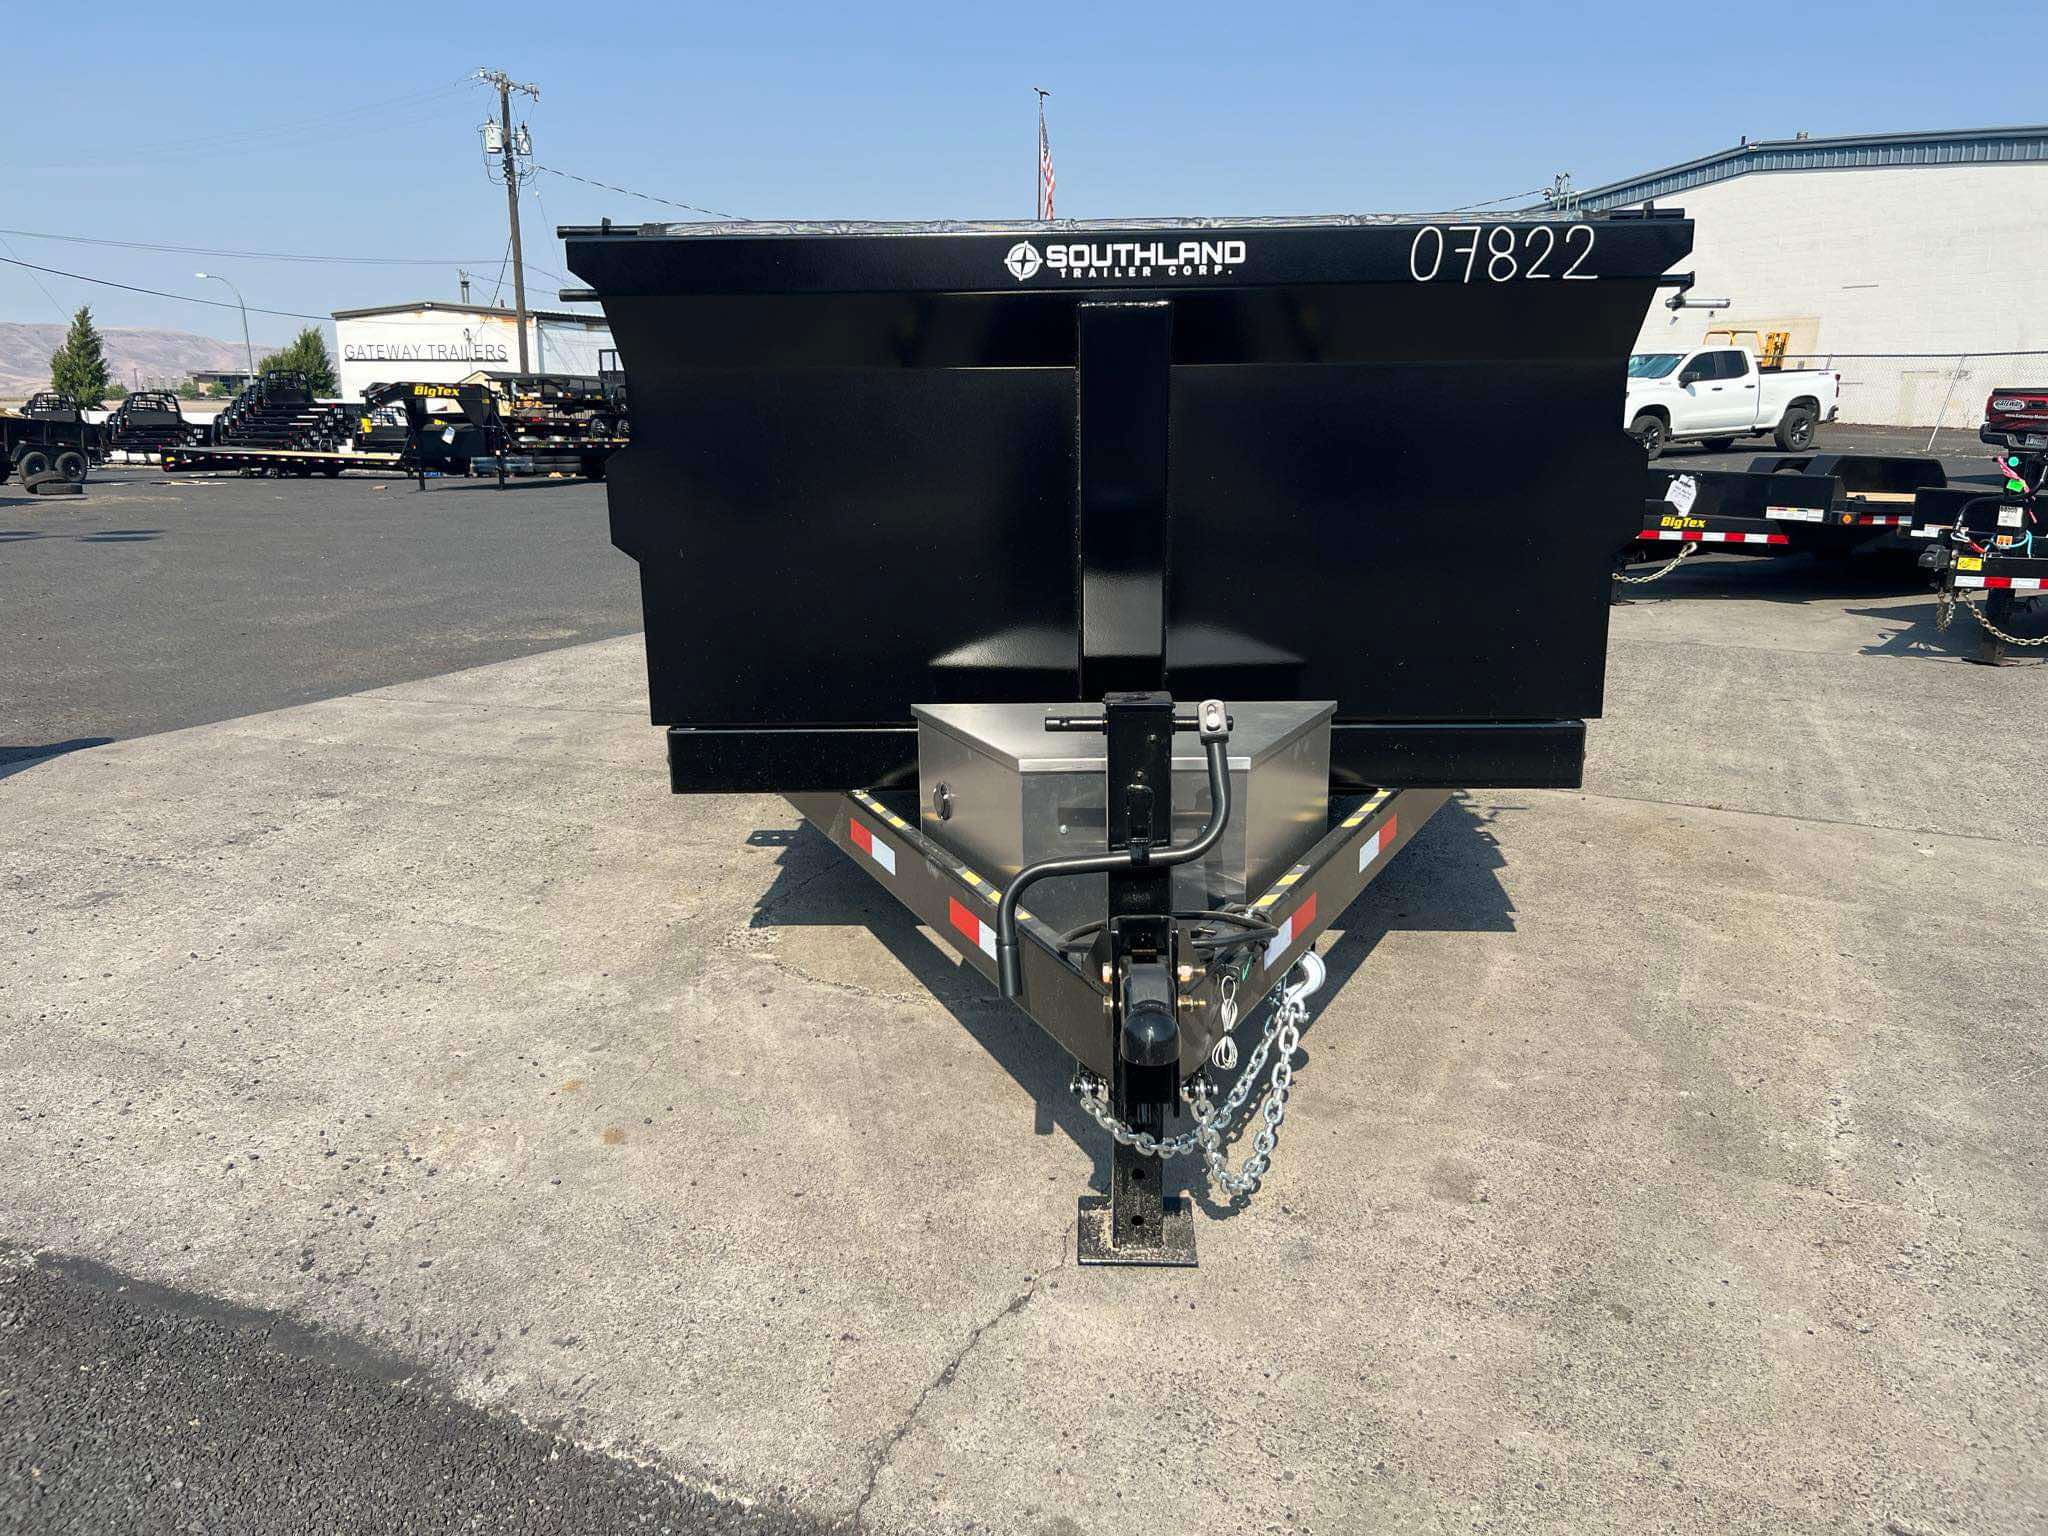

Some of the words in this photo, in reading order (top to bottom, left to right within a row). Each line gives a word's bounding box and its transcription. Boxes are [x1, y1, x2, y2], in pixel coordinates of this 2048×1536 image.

[1046, 240, 1247, 268] SOUTHLAND
[1410, 226, 1599, 283] 07822
[1059, 267, 1152, 278] TRAILER
[1168, 265, 1233, 276] CORP.
[344, 344, 421, 360] GATEWAY
[428, 344, 508, 360] TRAILERS
[413, 385, 461, 399] BigTex
[1660, 516, 1706, 529] BigTex
